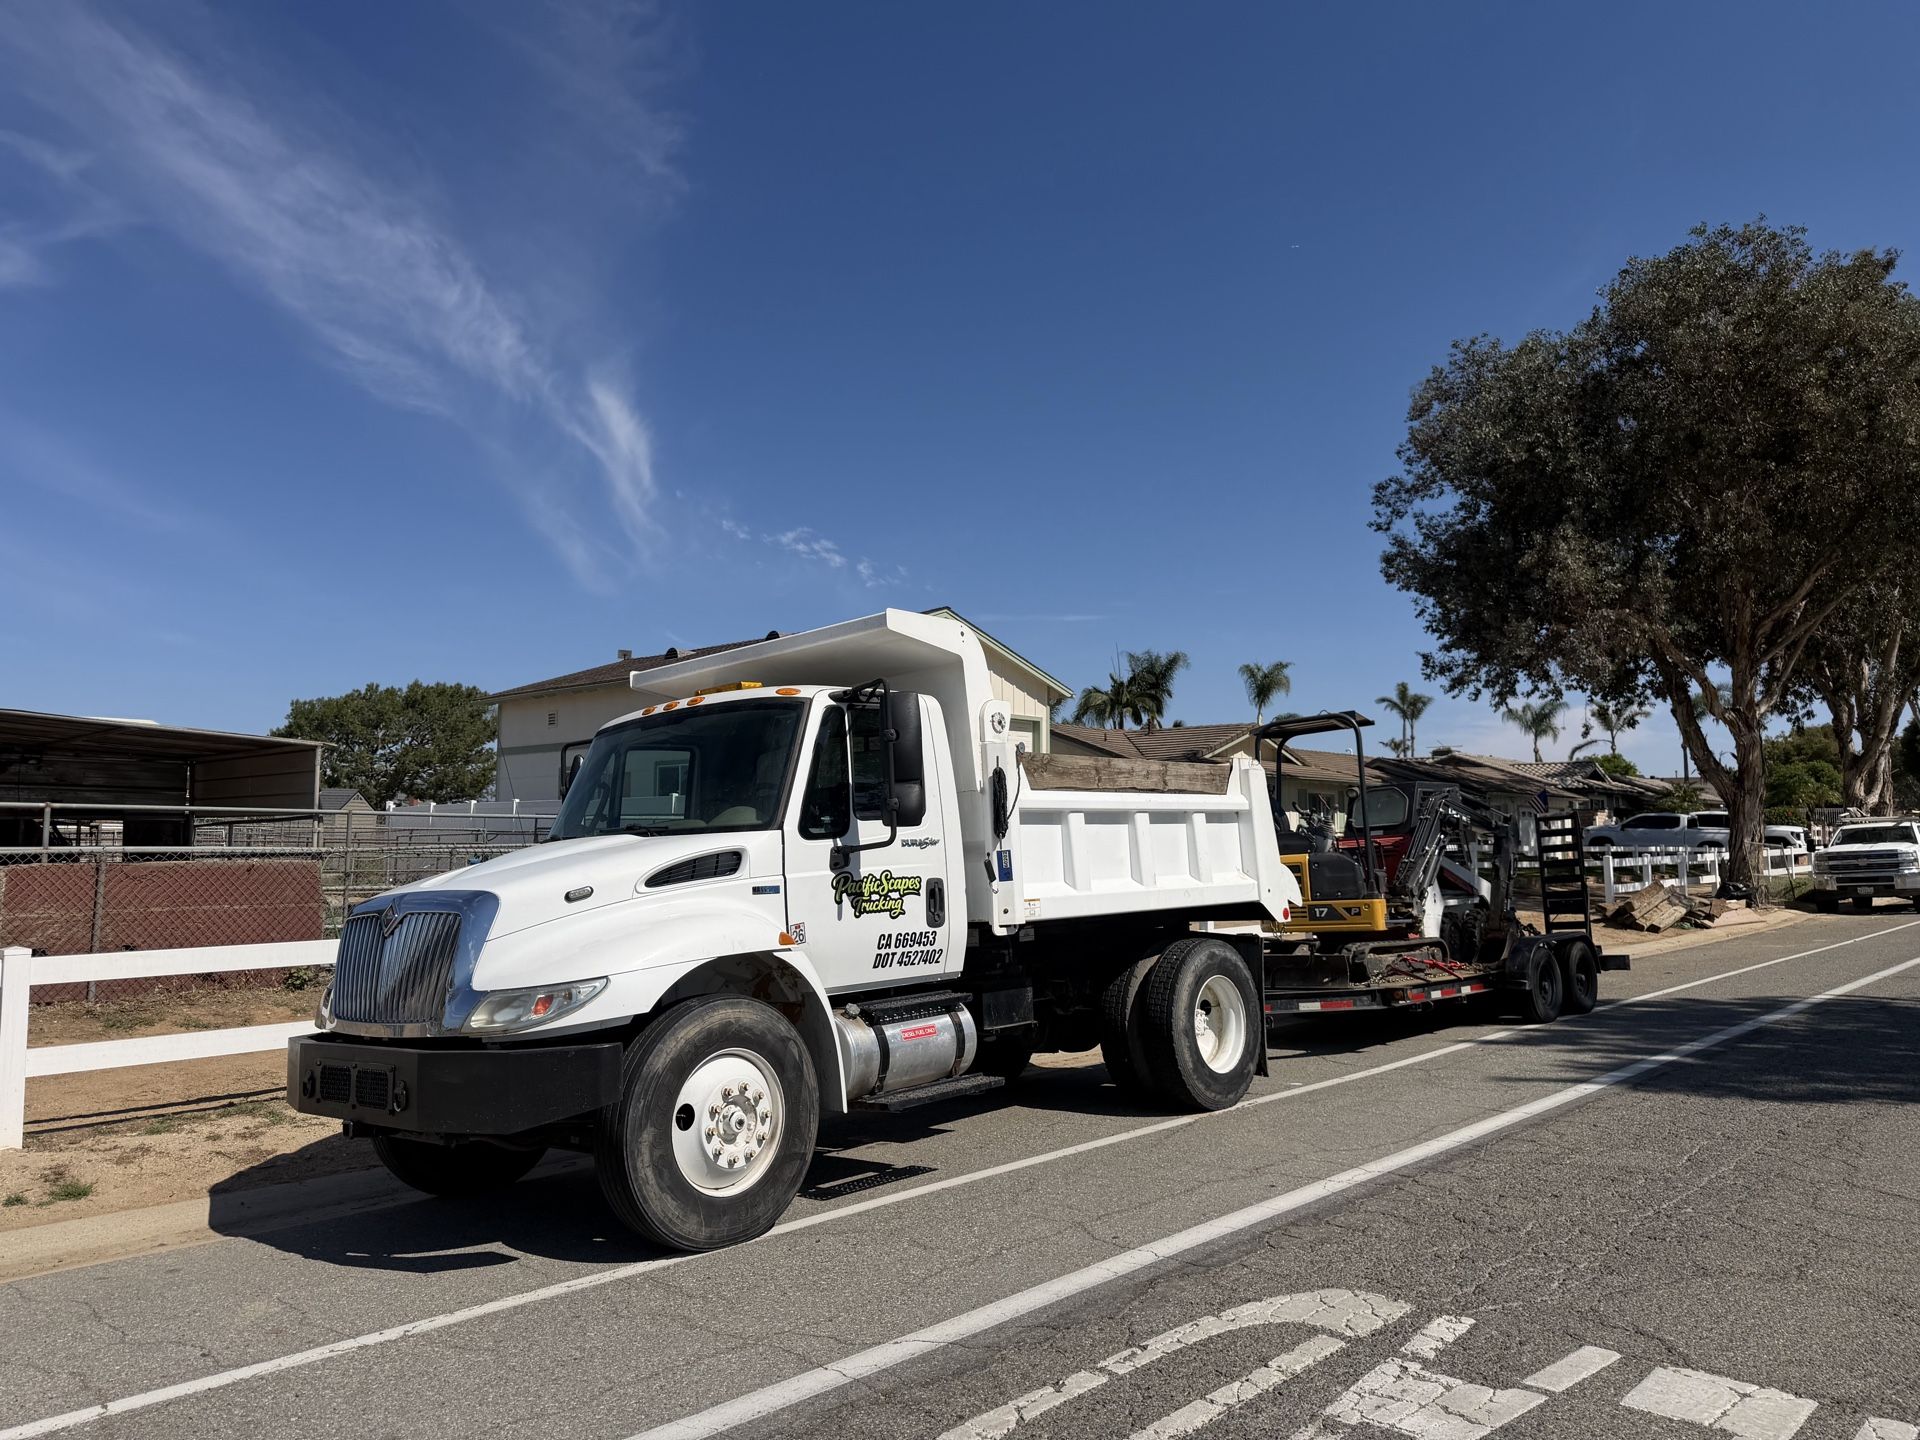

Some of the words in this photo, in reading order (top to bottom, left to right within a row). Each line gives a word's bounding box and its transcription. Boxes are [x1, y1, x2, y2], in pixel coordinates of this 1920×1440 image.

[852, 895, 906, 919] Trucking
[1314, 907, 1328, 917] 17
[792, 929, 805, 943] 26
[877, 933, 893, 950] CA
[894, 930, 937, 949] 669453
[872, 952, 897, 969] DOT
[896, 948, 943, 967] 4527402
